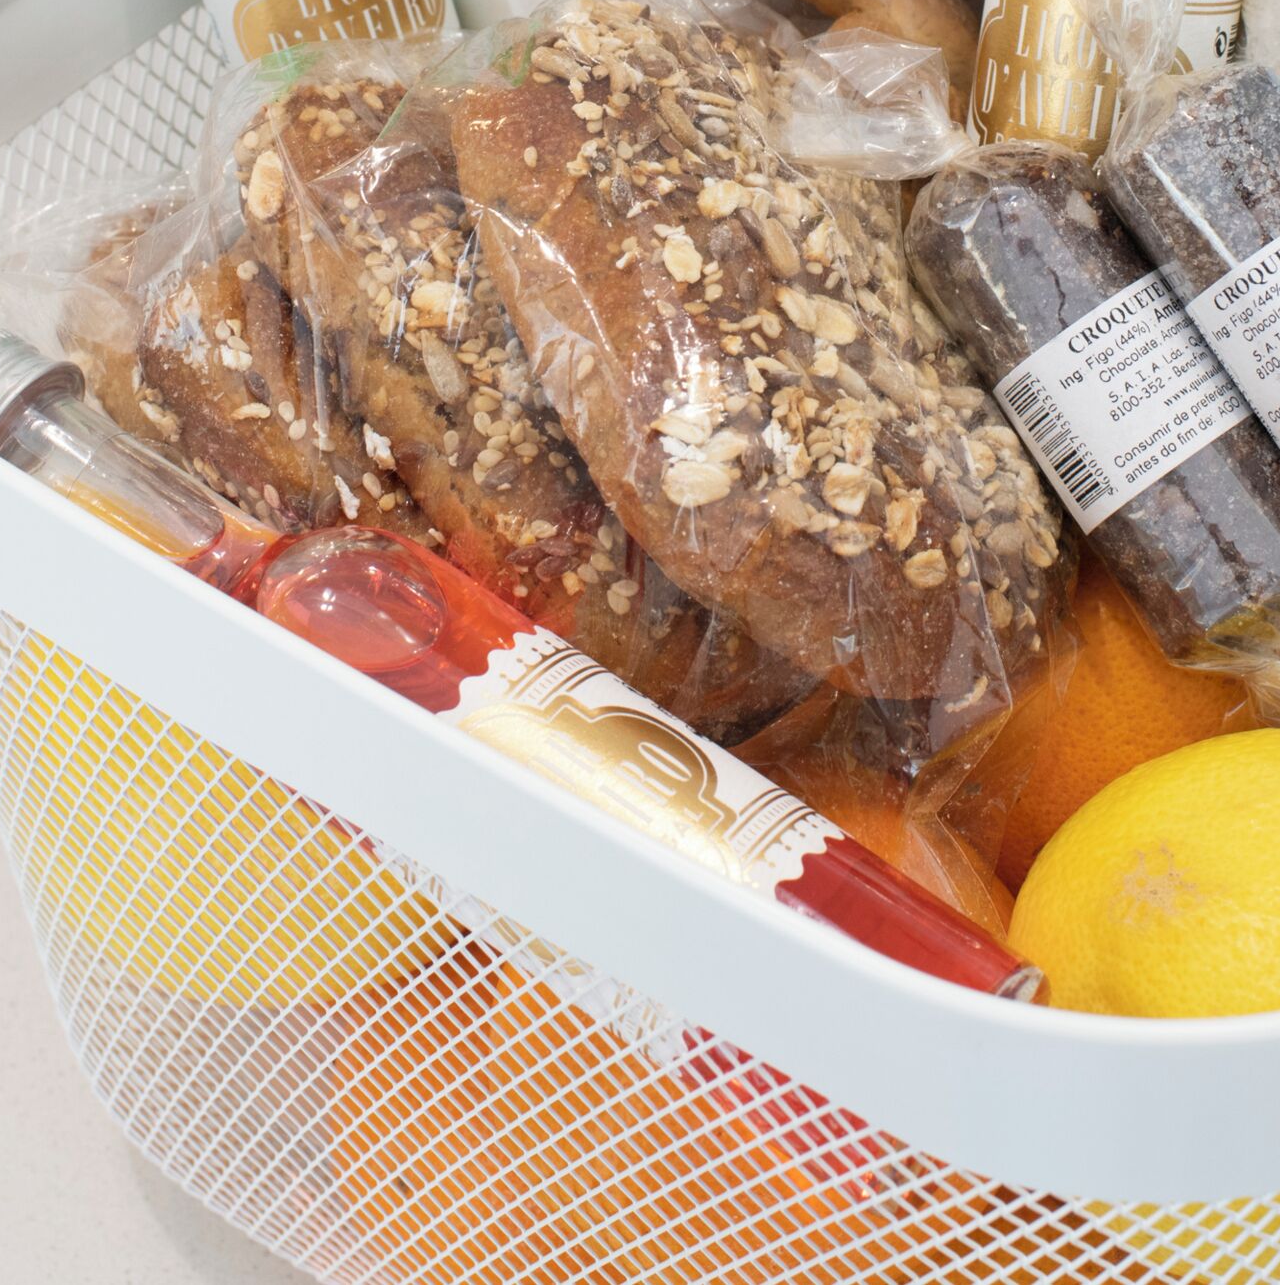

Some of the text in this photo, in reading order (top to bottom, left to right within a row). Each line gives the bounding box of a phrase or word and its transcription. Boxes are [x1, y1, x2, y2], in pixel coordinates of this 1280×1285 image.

[1067, 278, 1165, 353] CROQUETE
[1084, 346, 1114, 370] Figo
[1114, 320, 1150, 350] (44%)
[1153, 291, 1192, 323] Amên
[1229, 307, 1253, 327] Figo
[1109, 376, 1165, 421] 8100-352
[1113, 375, 1240, 468] Consumir de preferênc
[1125, 454, 1159, 483] antes
[1160, 442, 1177, 457] do
[1176, 427, 1197, 445] fim
